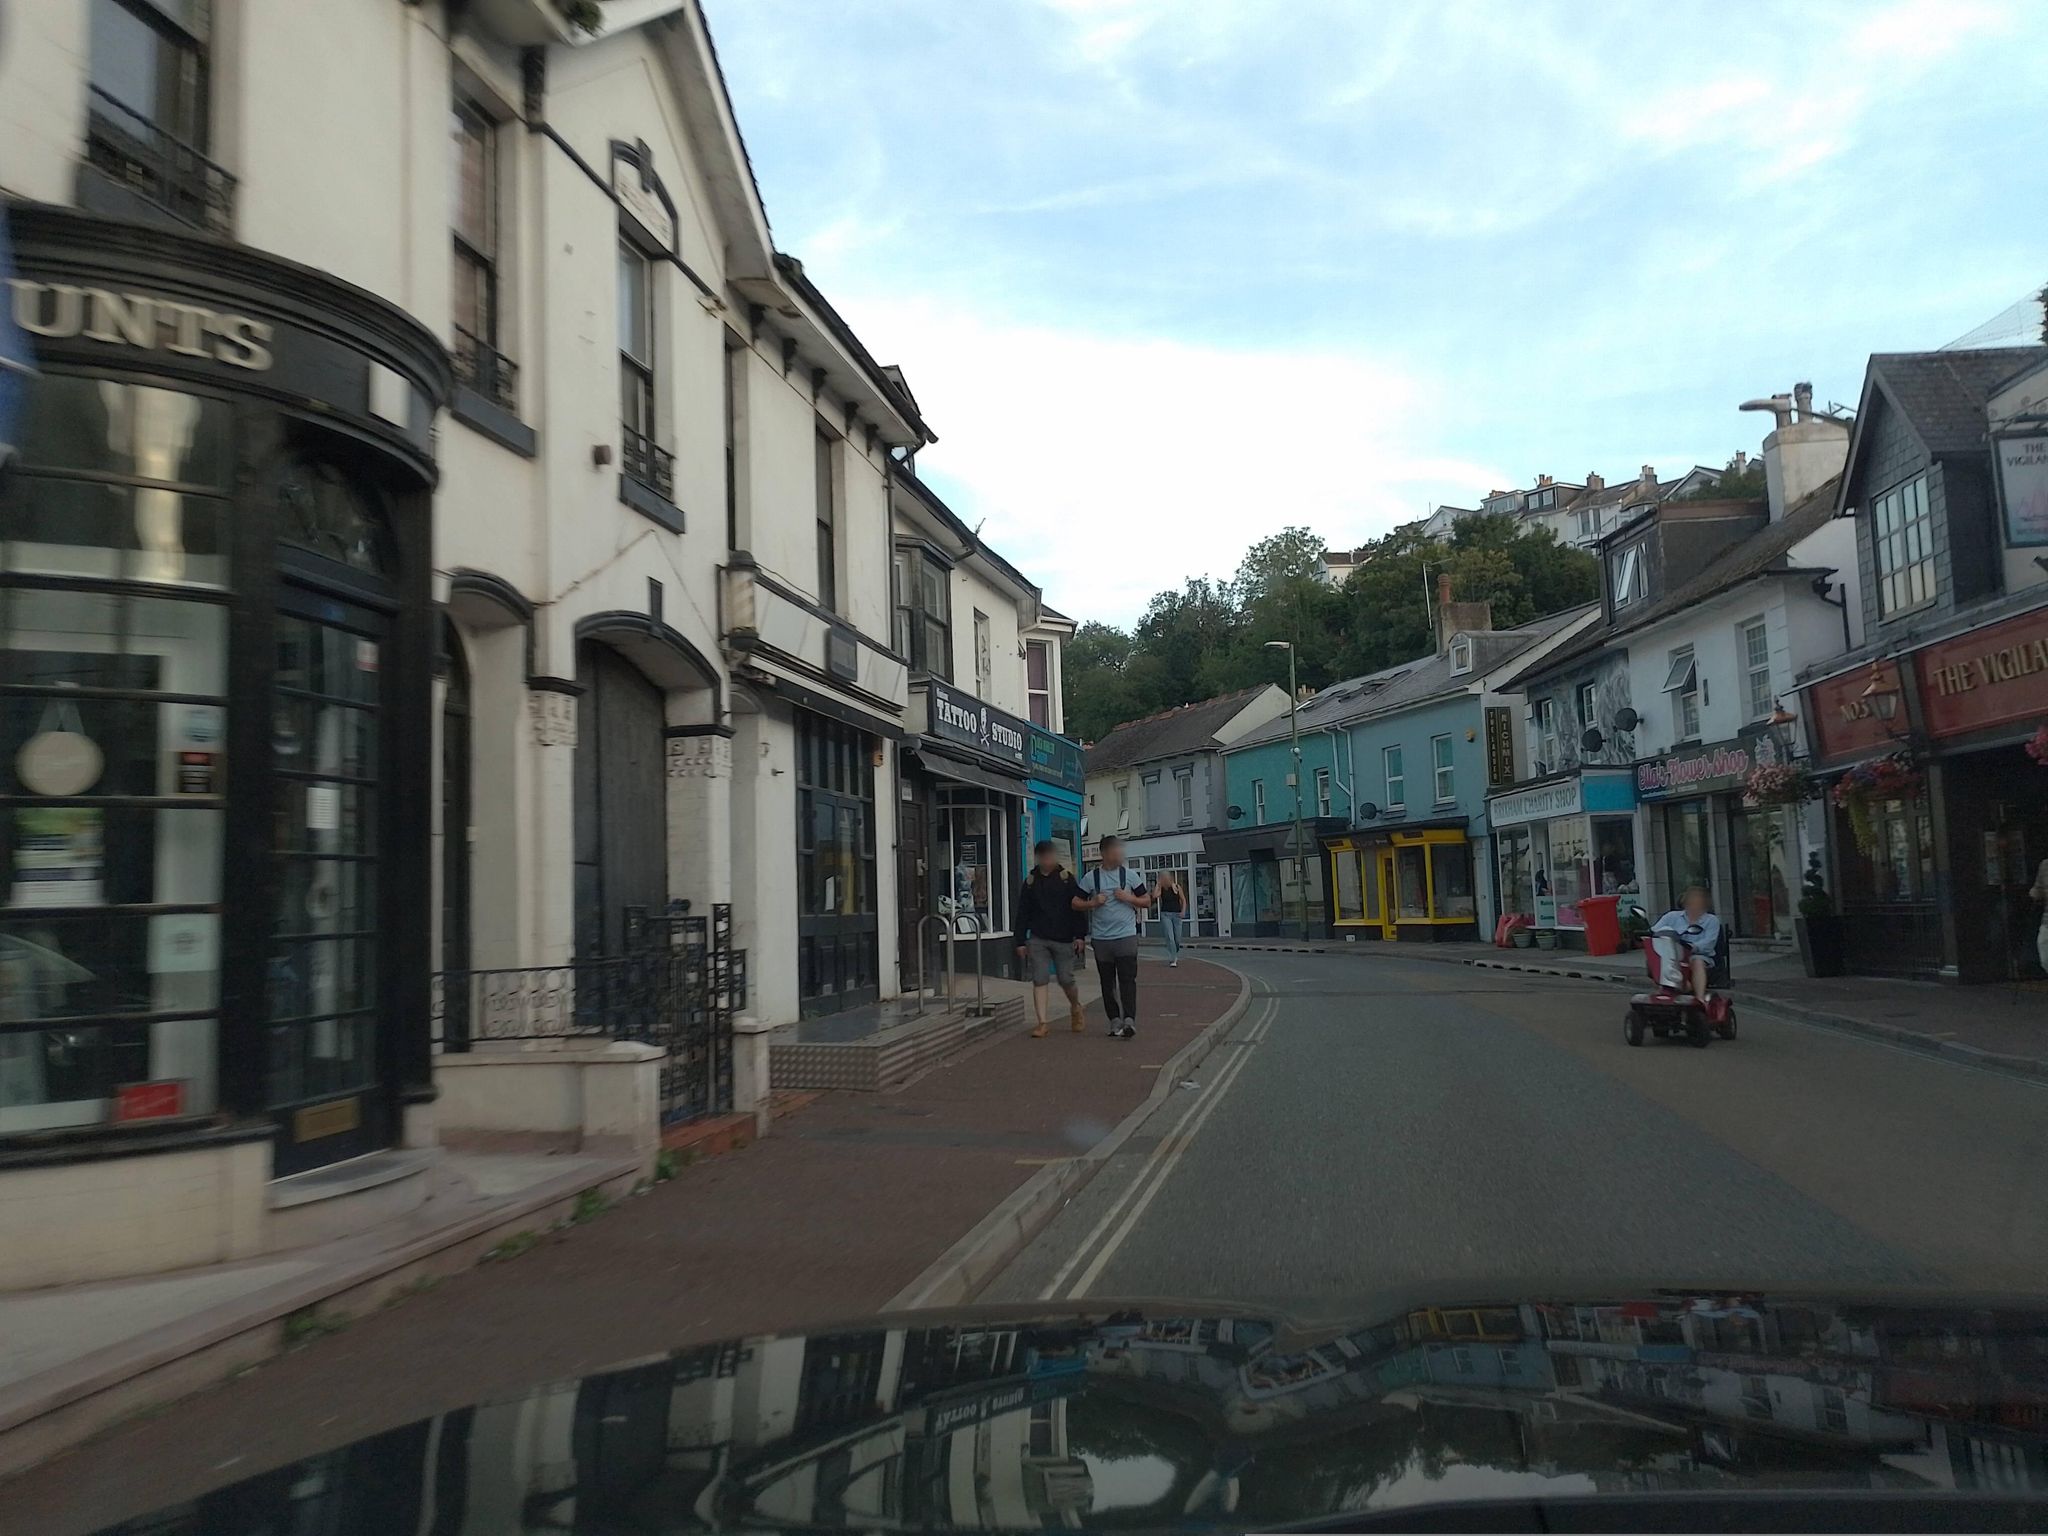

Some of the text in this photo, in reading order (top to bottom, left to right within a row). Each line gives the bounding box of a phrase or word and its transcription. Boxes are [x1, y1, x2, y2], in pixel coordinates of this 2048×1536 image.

[2023, 442, 2047, 453] THE
[1933, 637, 2048, 697] THE VIGILA
[936, 699, 1023, 752] TATTOO STUDIO
[1501, 713, 1513, 774] RICHMIX
[1666, 754, 1713, 786] Flower
[1524, 791, 1553, 814] CHARITY
[1555, 786, 1577, 809] SHOP
